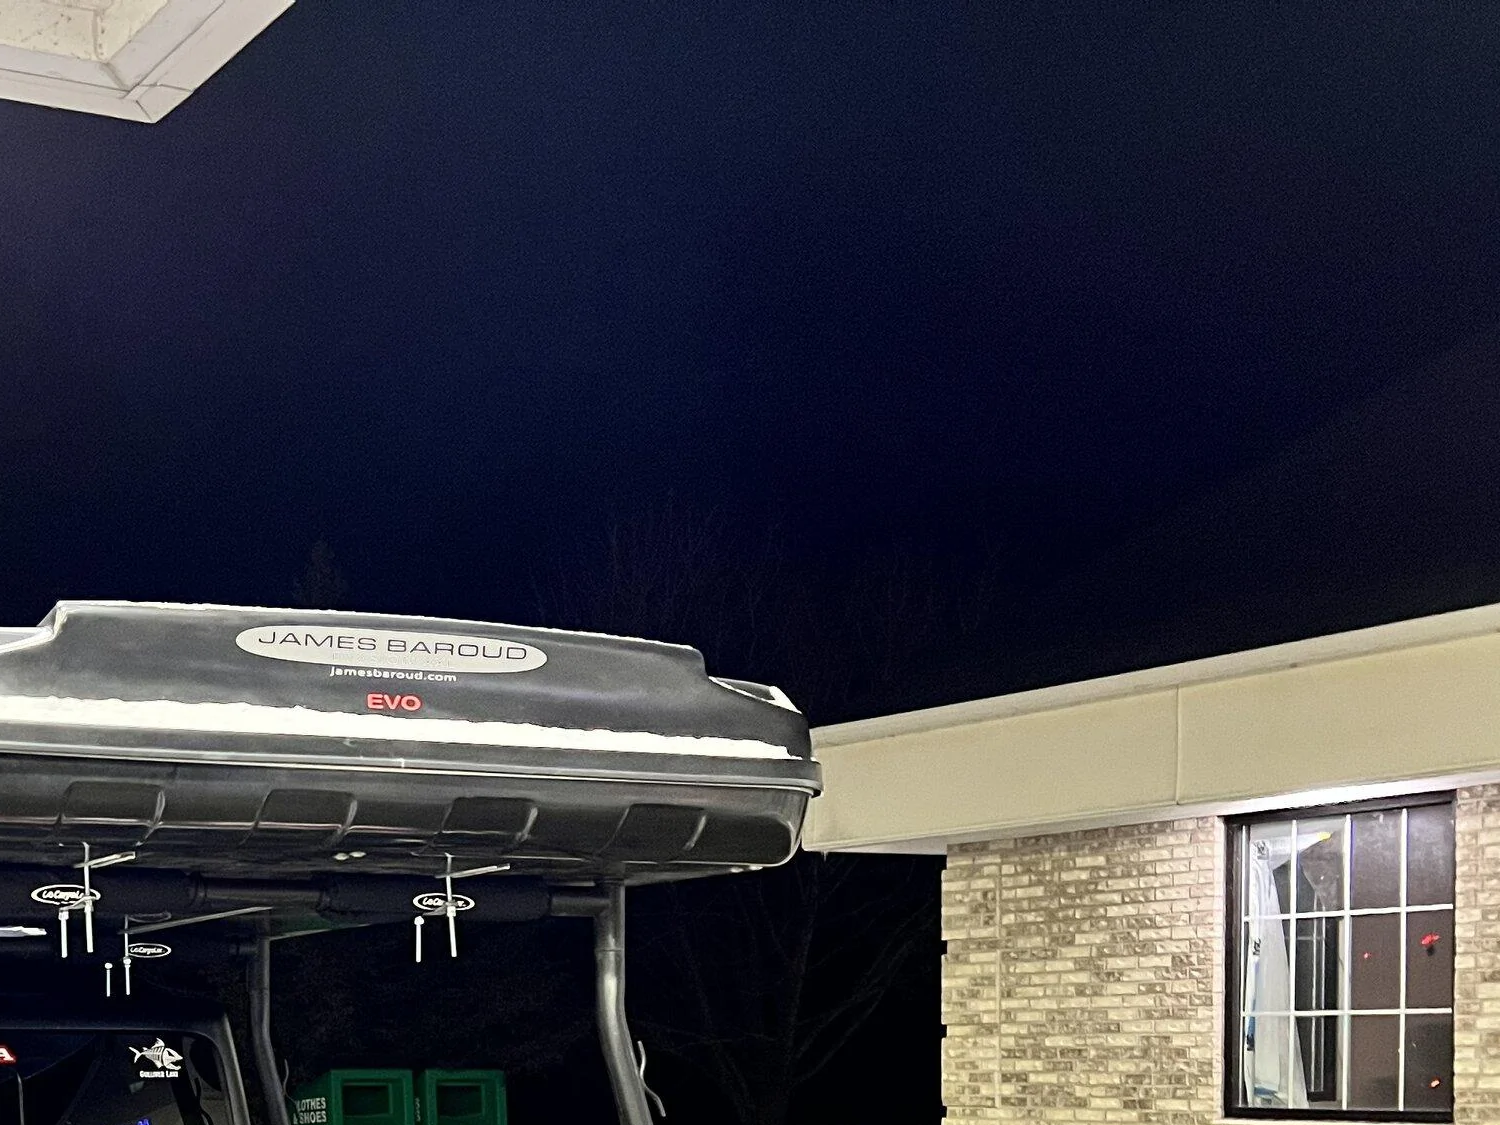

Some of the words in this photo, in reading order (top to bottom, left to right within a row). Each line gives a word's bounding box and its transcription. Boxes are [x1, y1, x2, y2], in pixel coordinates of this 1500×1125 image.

[258, 631, 377, 651] JAMES
[387, 639, 527, 660] BAROUD
[329, 666, 457, 682] jamesbaroud.com
[366, 693, 421, 711] EVO
[295, 1097, 326, 1112] LOTHES
[299, 1110, 327, 1125] SHOES
